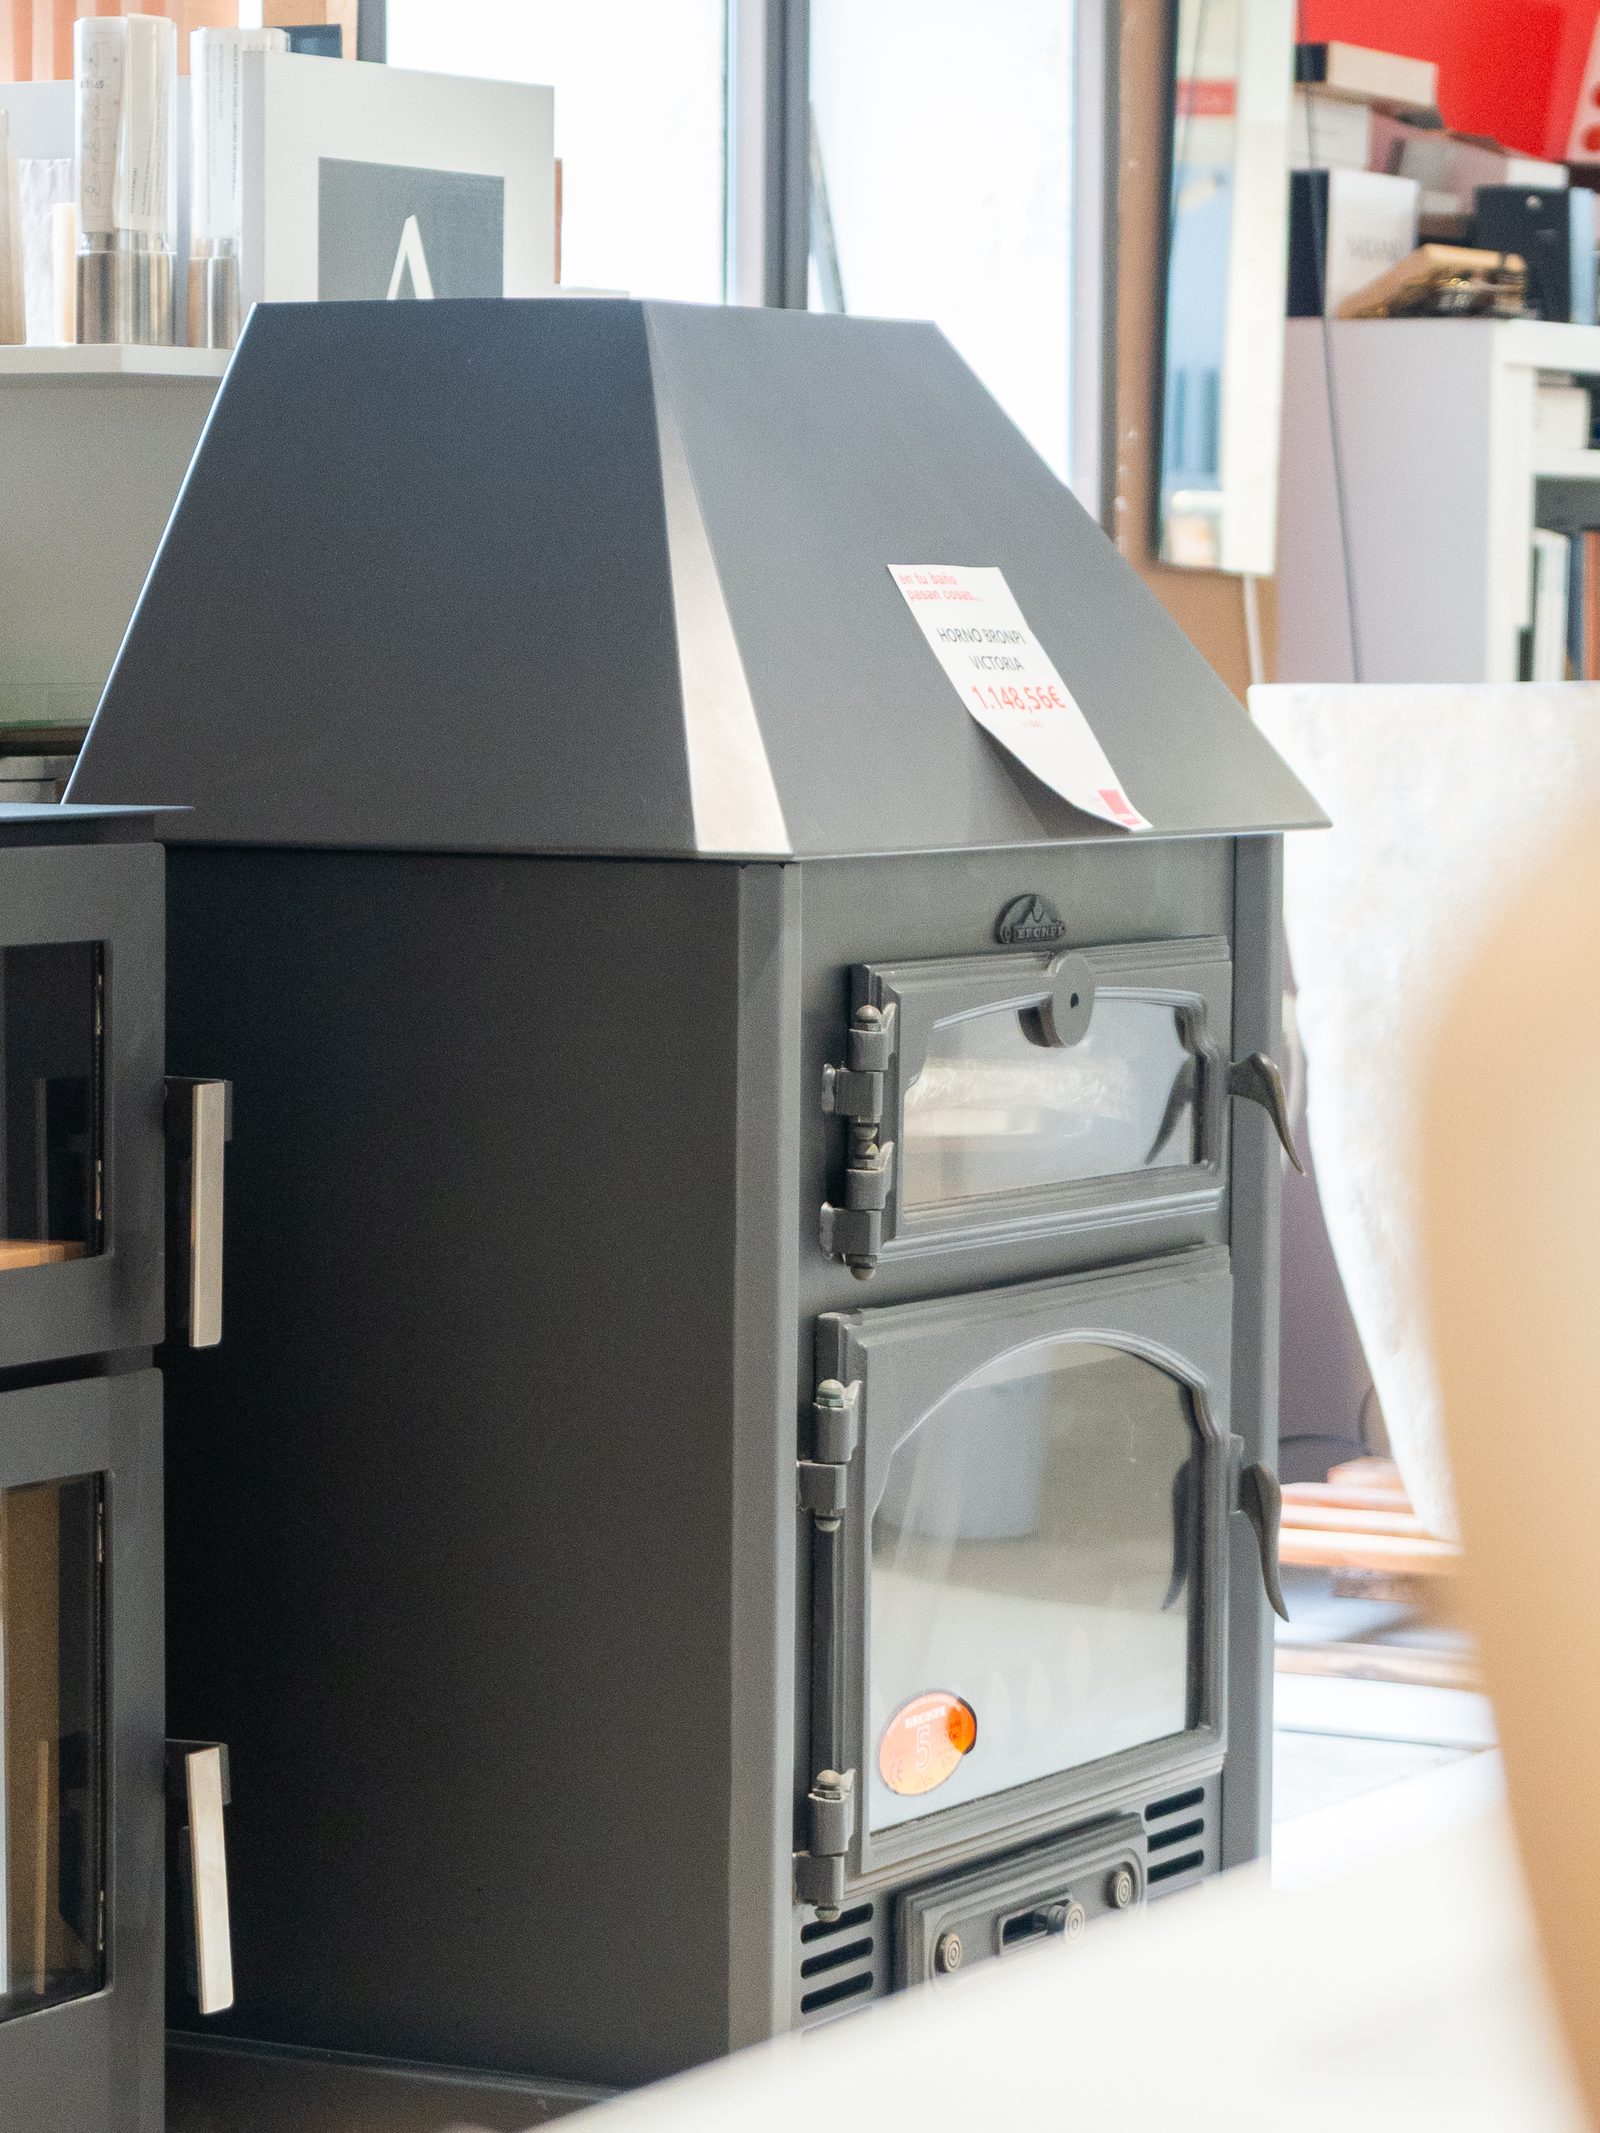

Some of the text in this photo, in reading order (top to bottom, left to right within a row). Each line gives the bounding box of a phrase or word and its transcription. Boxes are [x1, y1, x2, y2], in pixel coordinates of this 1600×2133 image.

[936, 628, 1026, 645] HORNO BRONPI
[968, 655, 1025, 670] VICTORIA
[971, 685, 1067, 713] 1.148,56€
[915, 1724, 931, 1772] 5
